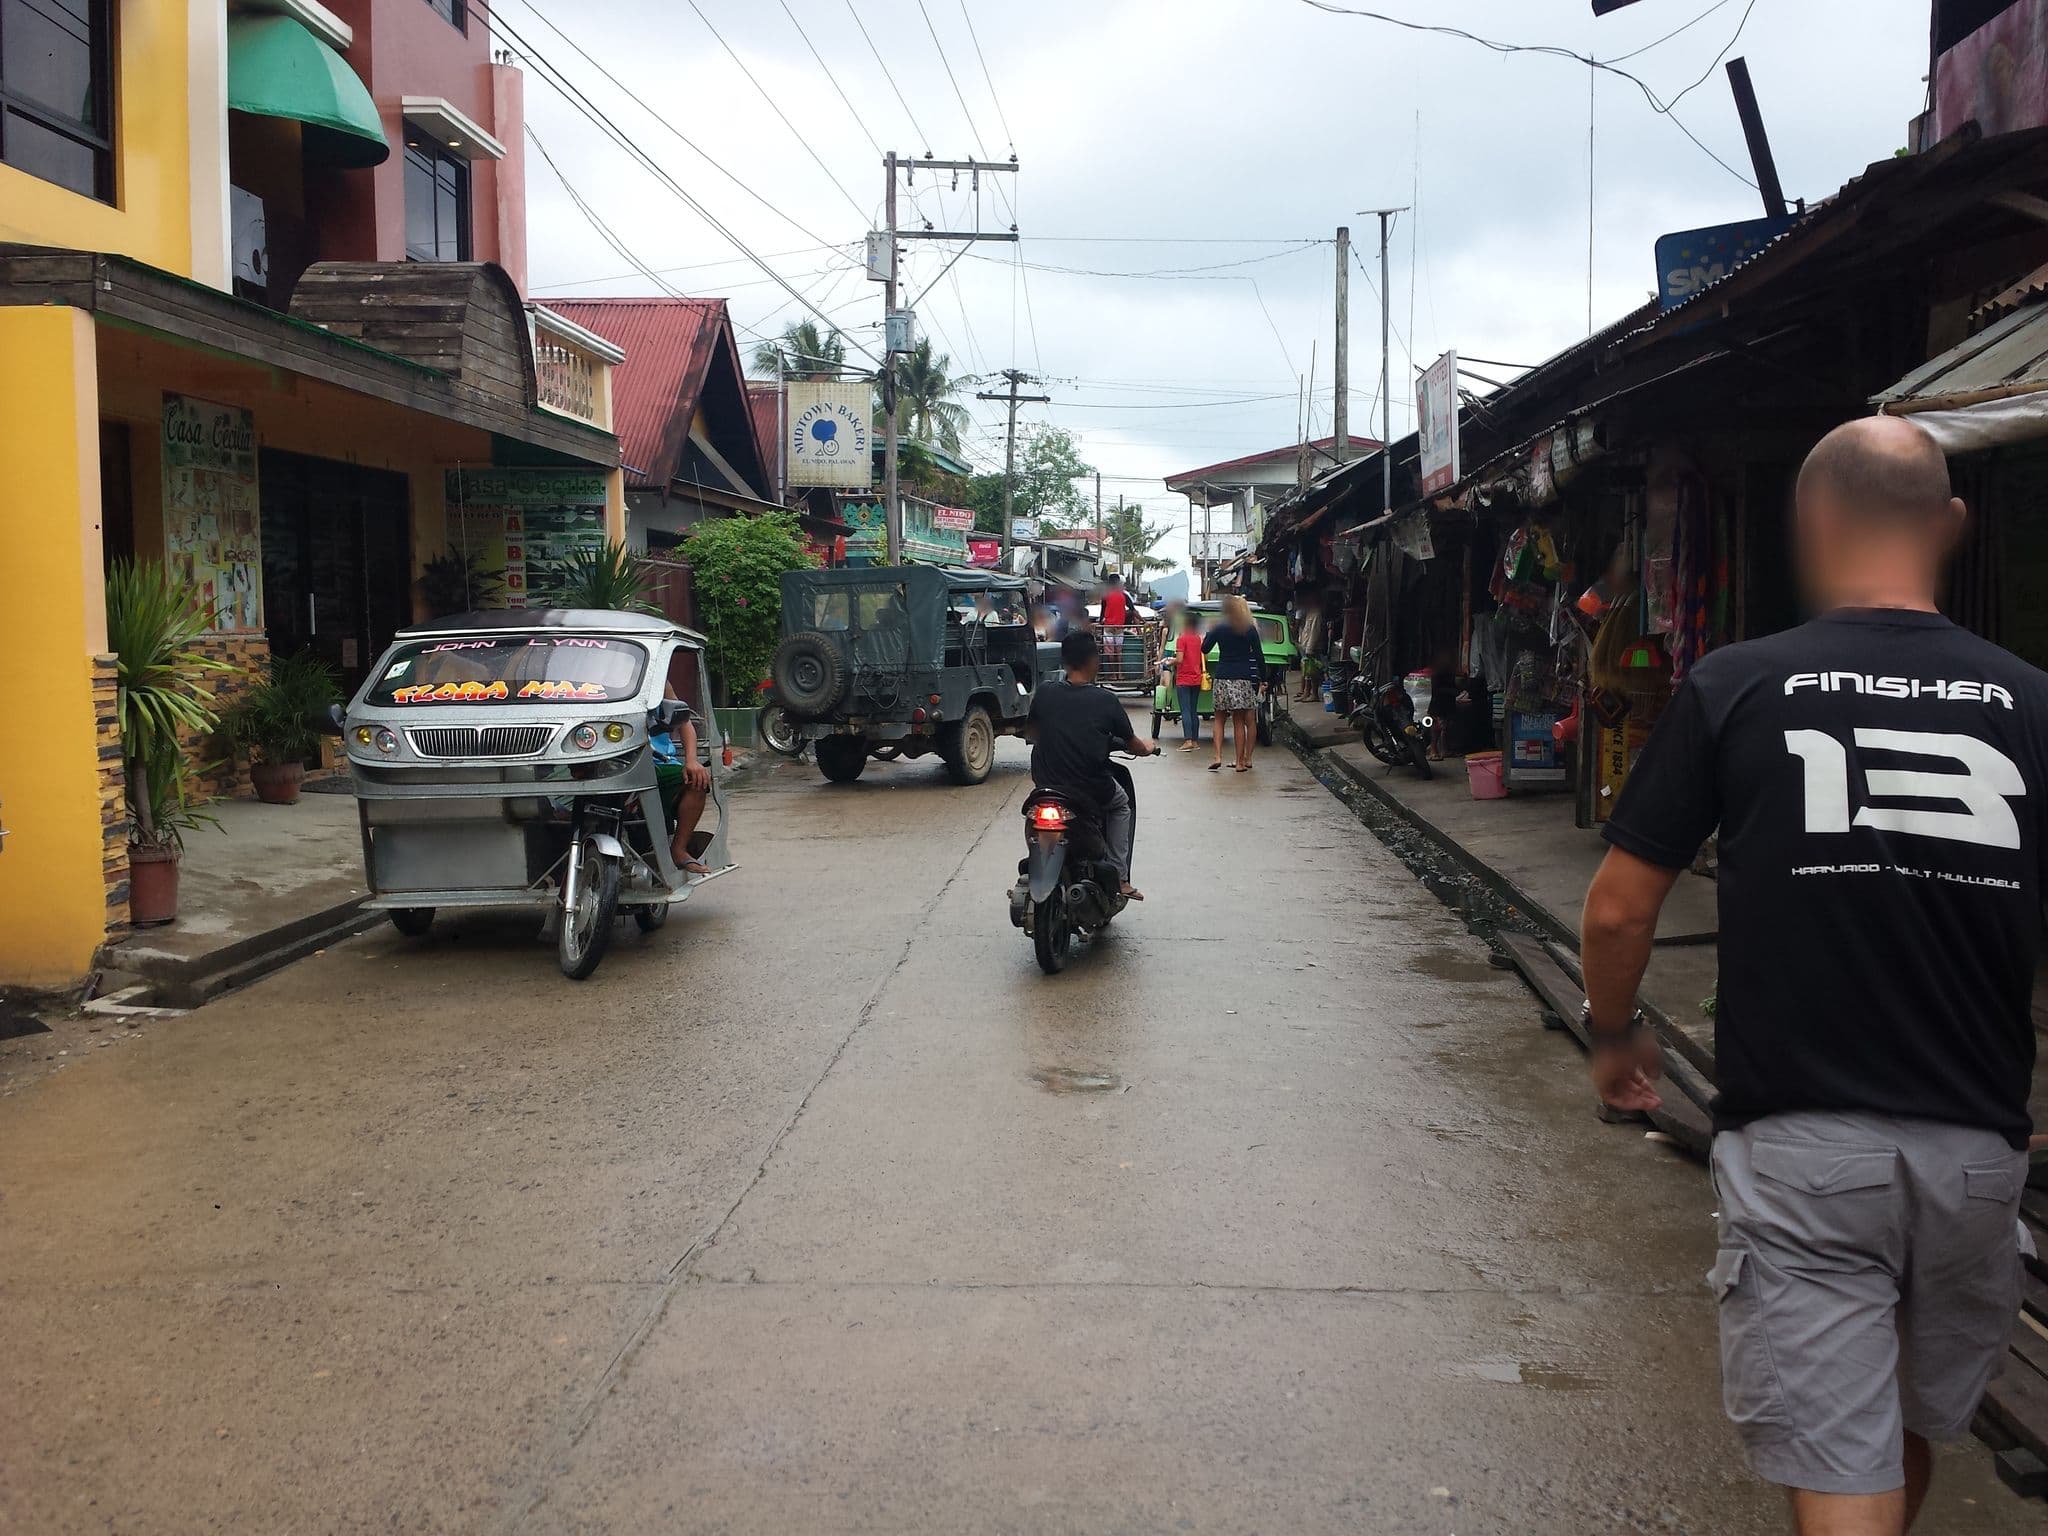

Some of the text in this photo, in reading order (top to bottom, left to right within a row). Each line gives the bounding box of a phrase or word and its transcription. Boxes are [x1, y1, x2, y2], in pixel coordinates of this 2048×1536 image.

[166, 404, 251, 451] Casa Cecilia
[793, 401, 866, 456] MIDTOWN BAKERY
[507, 516, 521, 531] A
[937, 509, 971, 519] EL NIDO
[507, 546, 523, 561] B
[508, 574, 523, 588] C
[421, 638, 609, 654] JOHN LYNN
[391, 680, 608, 704] FLORA MAE
[1783, 671, 2014, 711] FINISHER
[1612, 720, 1624, 746] INCE
[1783, 727, 2027, 850] 13
[1936, 871, 2021, 890] HULLUDELE
